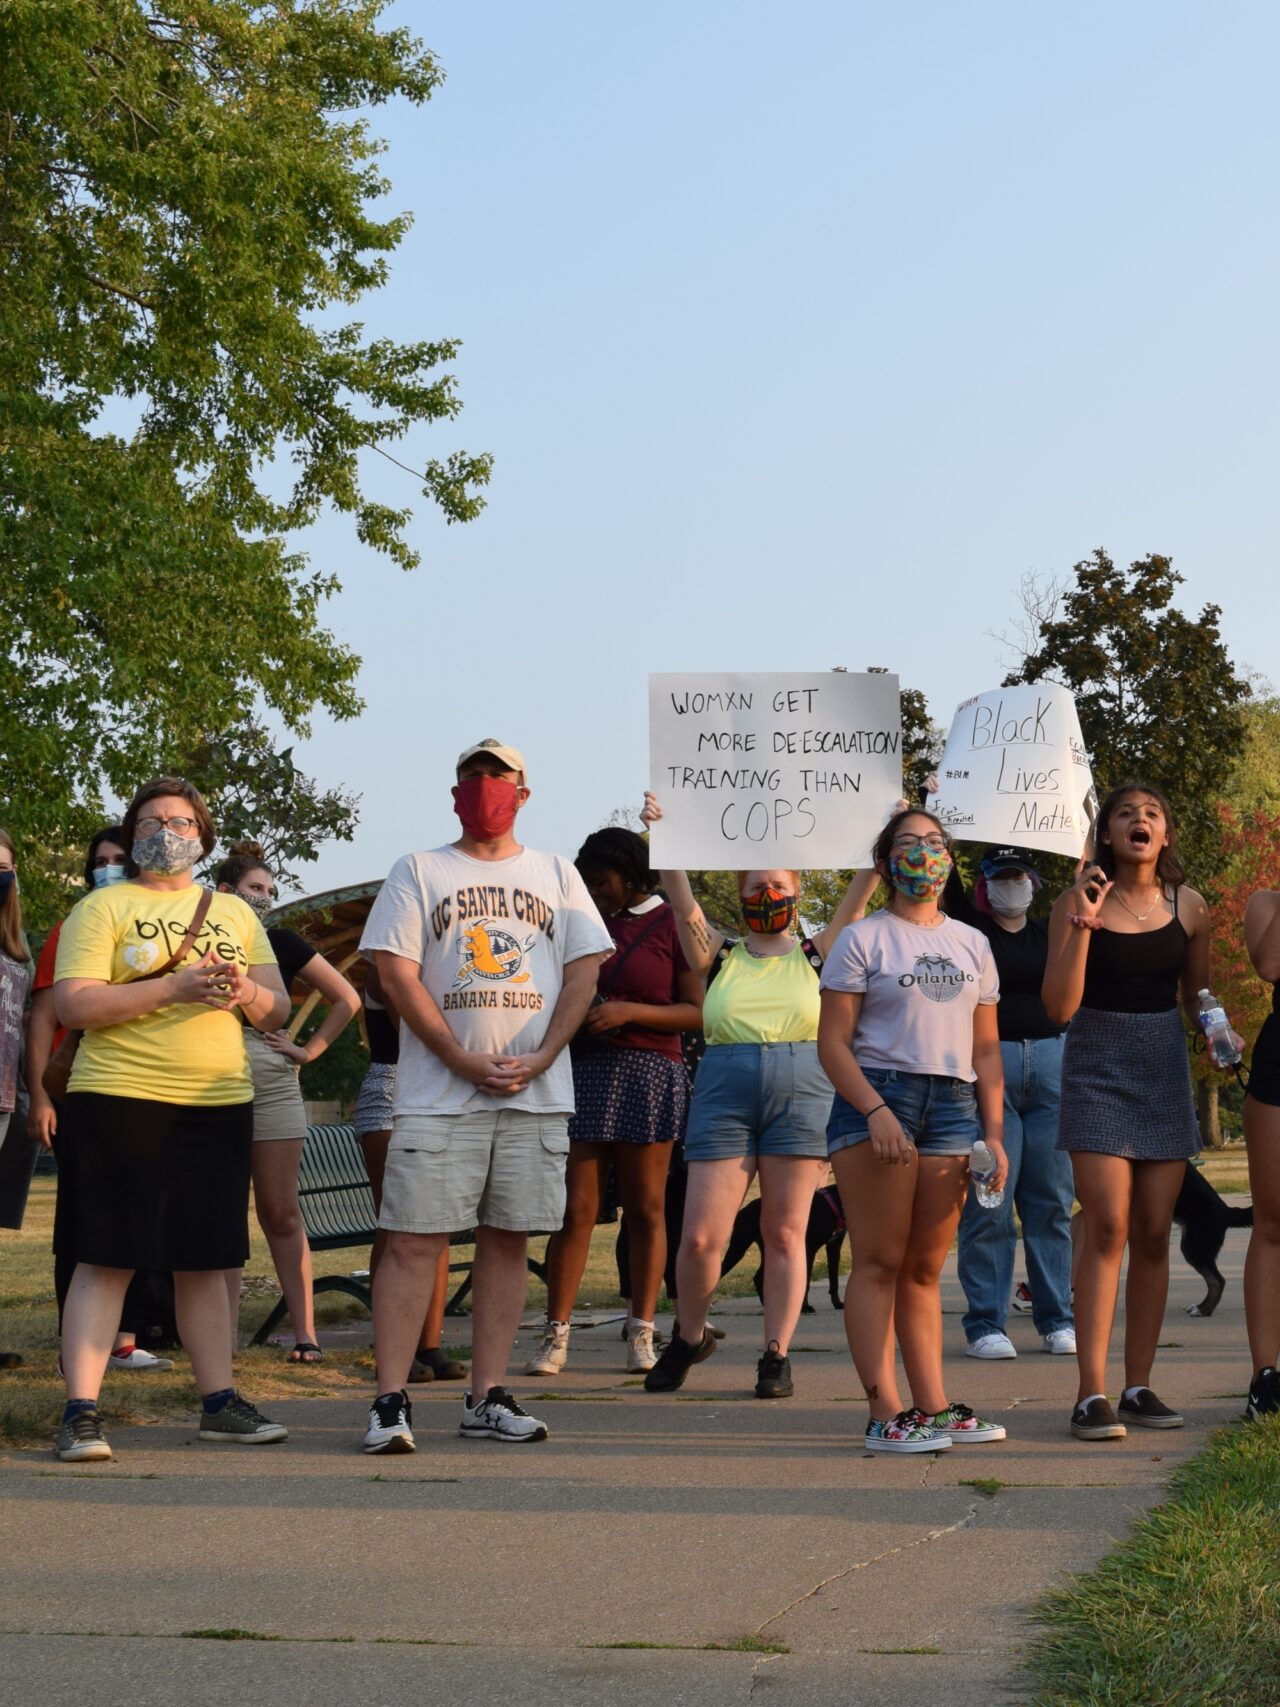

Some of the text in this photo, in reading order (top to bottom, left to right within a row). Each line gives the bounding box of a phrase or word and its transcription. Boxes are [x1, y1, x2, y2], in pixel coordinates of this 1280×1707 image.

[671, 688, 819, 715] WOMXN GET
[971, 696, 1052, 750] Black
[698, 730, 899, 755] MORE DE-ESCALATION
[668, 766, 861, 793] TRAINING THAN
[945, 769, 970, 780] #BLM
[996, 747, 1061, 792] Lives
[721, 797, 816, 842] COPS
[1012, 801, 1083, 831] Matte
[431, 886, 556, 942] UC SANTA CRUZ
[898, 970, 974, 988] Orlando
[443, 990, 543, 1011] BANANA SLUGS
